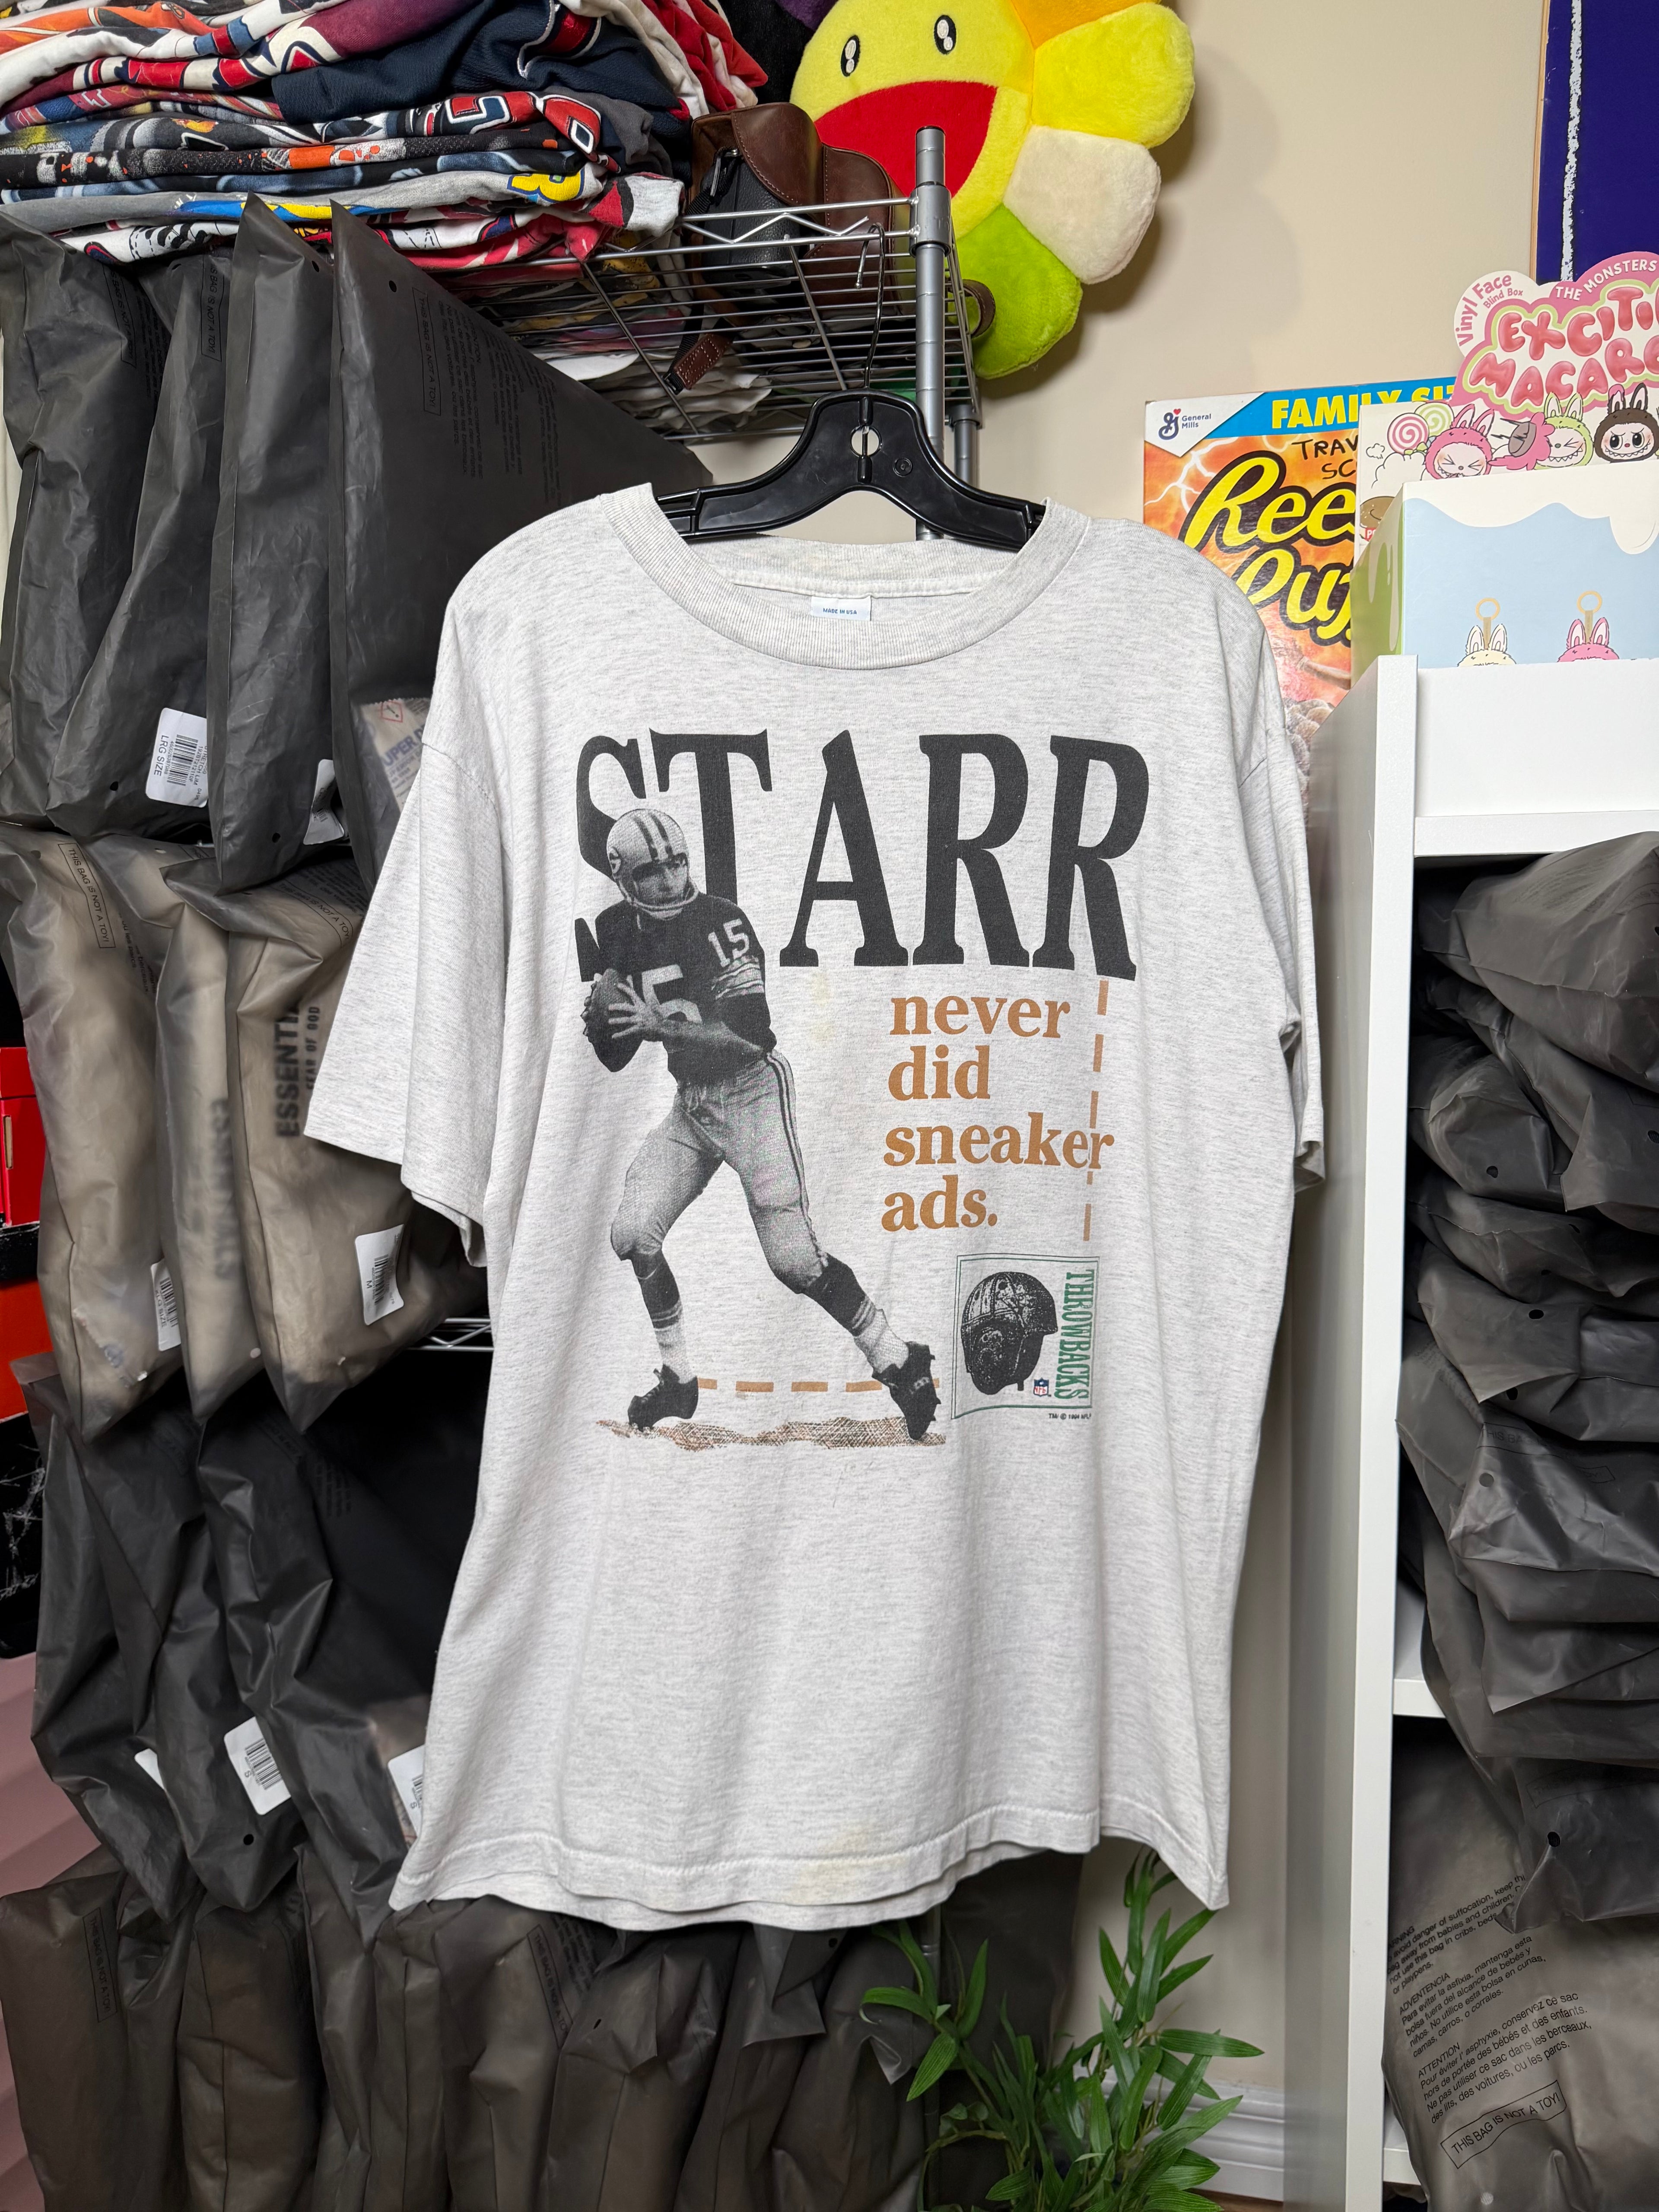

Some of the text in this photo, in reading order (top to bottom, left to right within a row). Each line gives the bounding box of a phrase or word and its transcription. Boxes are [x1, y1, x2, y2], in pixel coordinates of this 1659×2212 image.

[1483, 287, 1523, 308] Blind Box
[1555, 259, 1658, 301] THE MONSTERS
[1457, 275, 1512, 347] Vinyl Face
[1498, 286, 1659, 361] EXCITI
[1182, 413, 1211, 422] General
[153, 734, 169, 776] LRG SIZE
[575, 728, 1148, 982] STARR
[67, 848, 110, 943] THIS BAG IS NOT A TOY!
[318, 905, 336, 916] NOT
[708, 918, 750, 968] 15
[304, 1037, 318, 1052] OF
[889, 995, 1071, 1038] never
[888, 1044, 991, 1101] did
[883, 1111, 1115, 1169] sneaker
[881, 1174, 998, 1232] ads.
[365, 1280, 372, 1289] M
[1053, 1269, 1094, 1399] THROWBACKS
[243, 1769, 253, 1779] S
[409, 1801, 418, 1809] S
[1394, 1940, 1411, 1958] avoid
[1412, 1922, 1436, 1943] danger
[1439, 1916, 1446, 1926] of
[1449, 1892, 1492, 1922] suffocation,
[1495, 1880, 1513, 1896] keep
[1401, 1946, 1417, 1964] away
[1419, 1935, 1434, 1950] from
[1437, 1918, 1462, 1939] babies
[1465, 1910, 1479, 1924] and
[1482, 1891, 1513, 1915] children.
[1390, 1970, 1400, 1985] not
[1402, 1961, 1413, 1976] use
[1415, 1950, 1426, 1964] this
[1429, 1941, 1443, 1955] bag
[1445, 1936, 1452, 1945] in
[1455, 1923, 1475, 1941] cribs,
[1393, 1959, 1432, 1995] or playpens.
[1402, 1935, 1531, 2025] Para evitar la asfixia, mantenga esta
[1398, 1971, 1449, 2015] ADVENTENCIA
[1406, 1946, 1531, 2037] bolsa fuera del alcance de bebés y
[1409, 1954, 1545, 2048] niños. No utilice esta bolsa en cunas,
[1412, 1986, 1503, 2058] camas, carros, o corrales.
[1420, 2072, 1439, 2090] Pour
[1438, 2056, 1459, 2077] éviter
[1464, 2026, 1501, 2056] asphyxie,
[1501, 2000, 1545, 2030] conservez
[1545, 1996, 1558, 2007] ce
[1560, 1991, 1579, 2005] sac
[1417, 2041, 1461, 2079] ATTENTION
[1423, 2004, 1587, 2101] hors de portée des bébés et des enfants.
[1426, 2020, 1592, 2112] Ne pas utiliser ce sac dans les berceaux,
[1430, 2038, 1569, 2125] des lits, des voitures, ou les parcs.
[1451, 2091, 1561, 2155] THIS BAG IS NOT A TOY!
